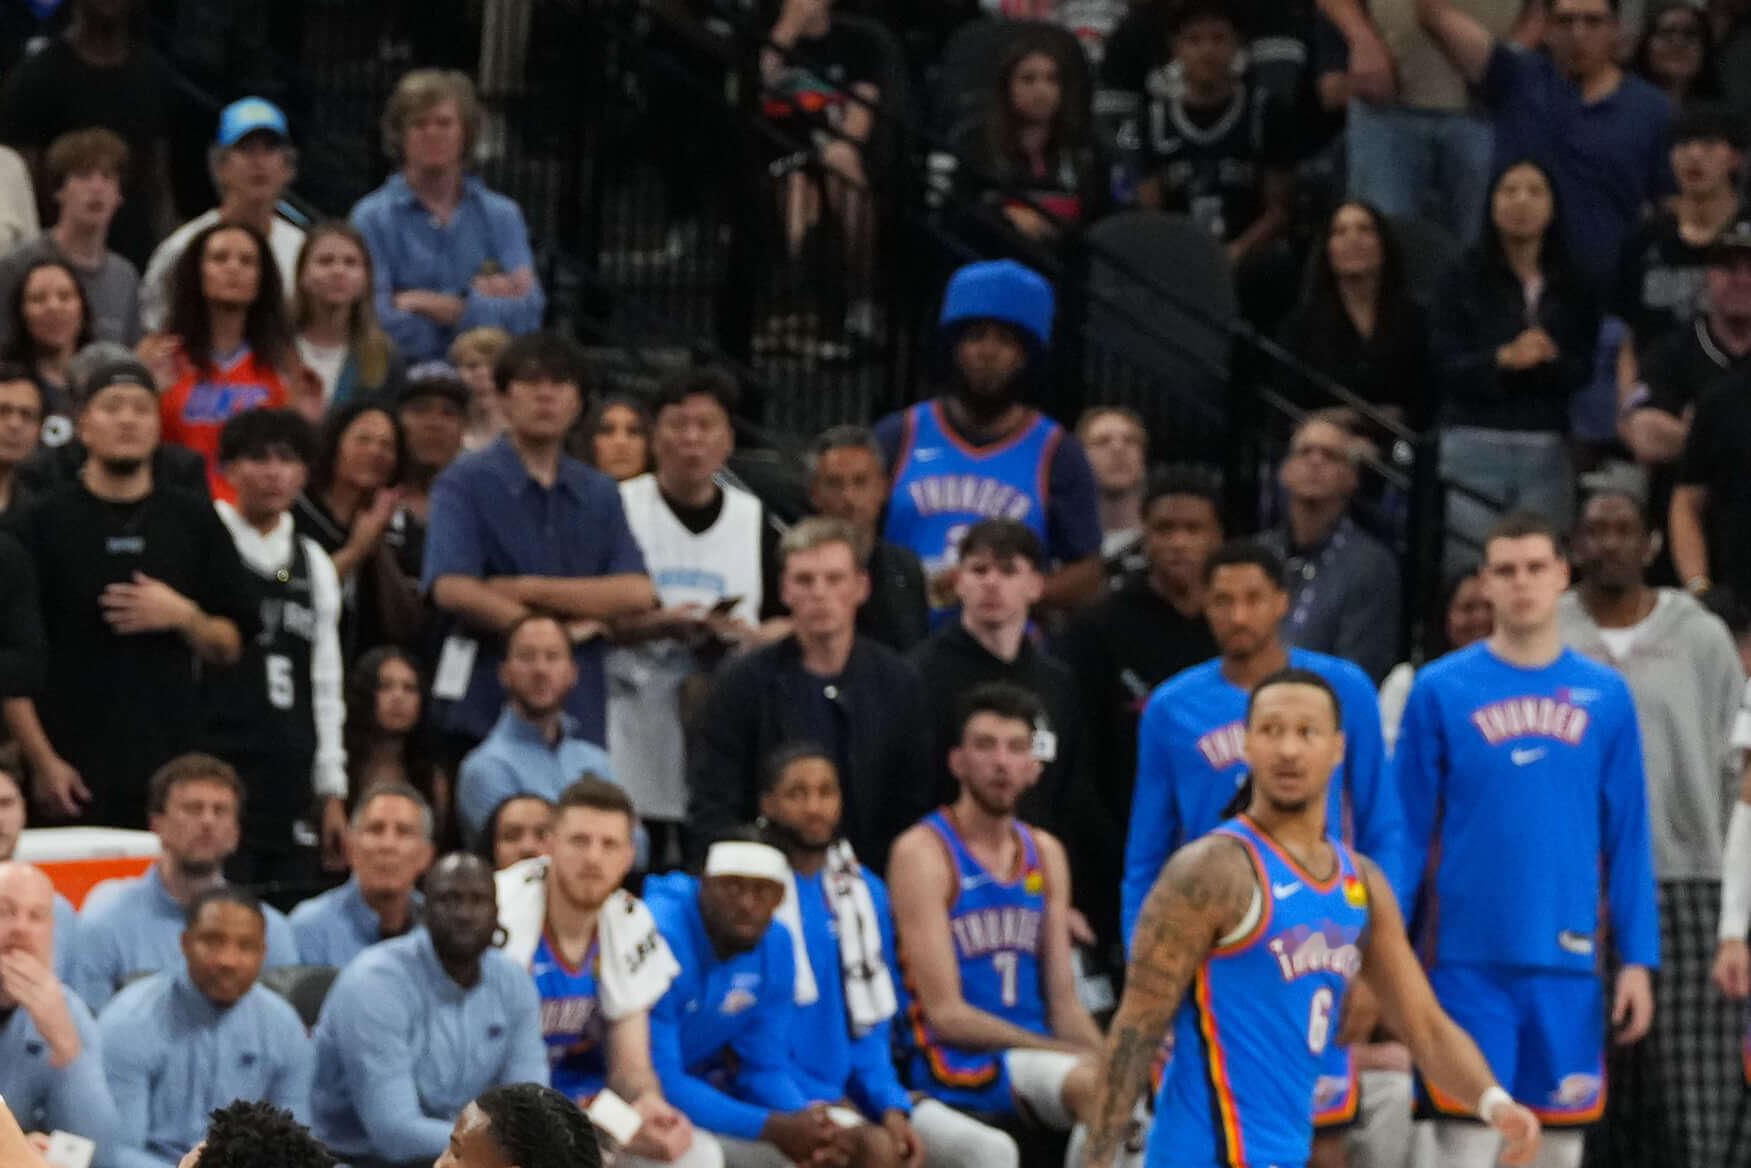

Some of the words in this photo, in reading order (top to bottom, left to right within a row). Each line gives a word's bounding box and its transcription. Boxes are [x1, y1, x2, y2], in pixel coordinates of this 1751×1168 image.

[1472, 696, 1589, 746] THUNDER
[993, 951, 1017, 1008] 7
[1308, 987, 1333, 1054] 6
